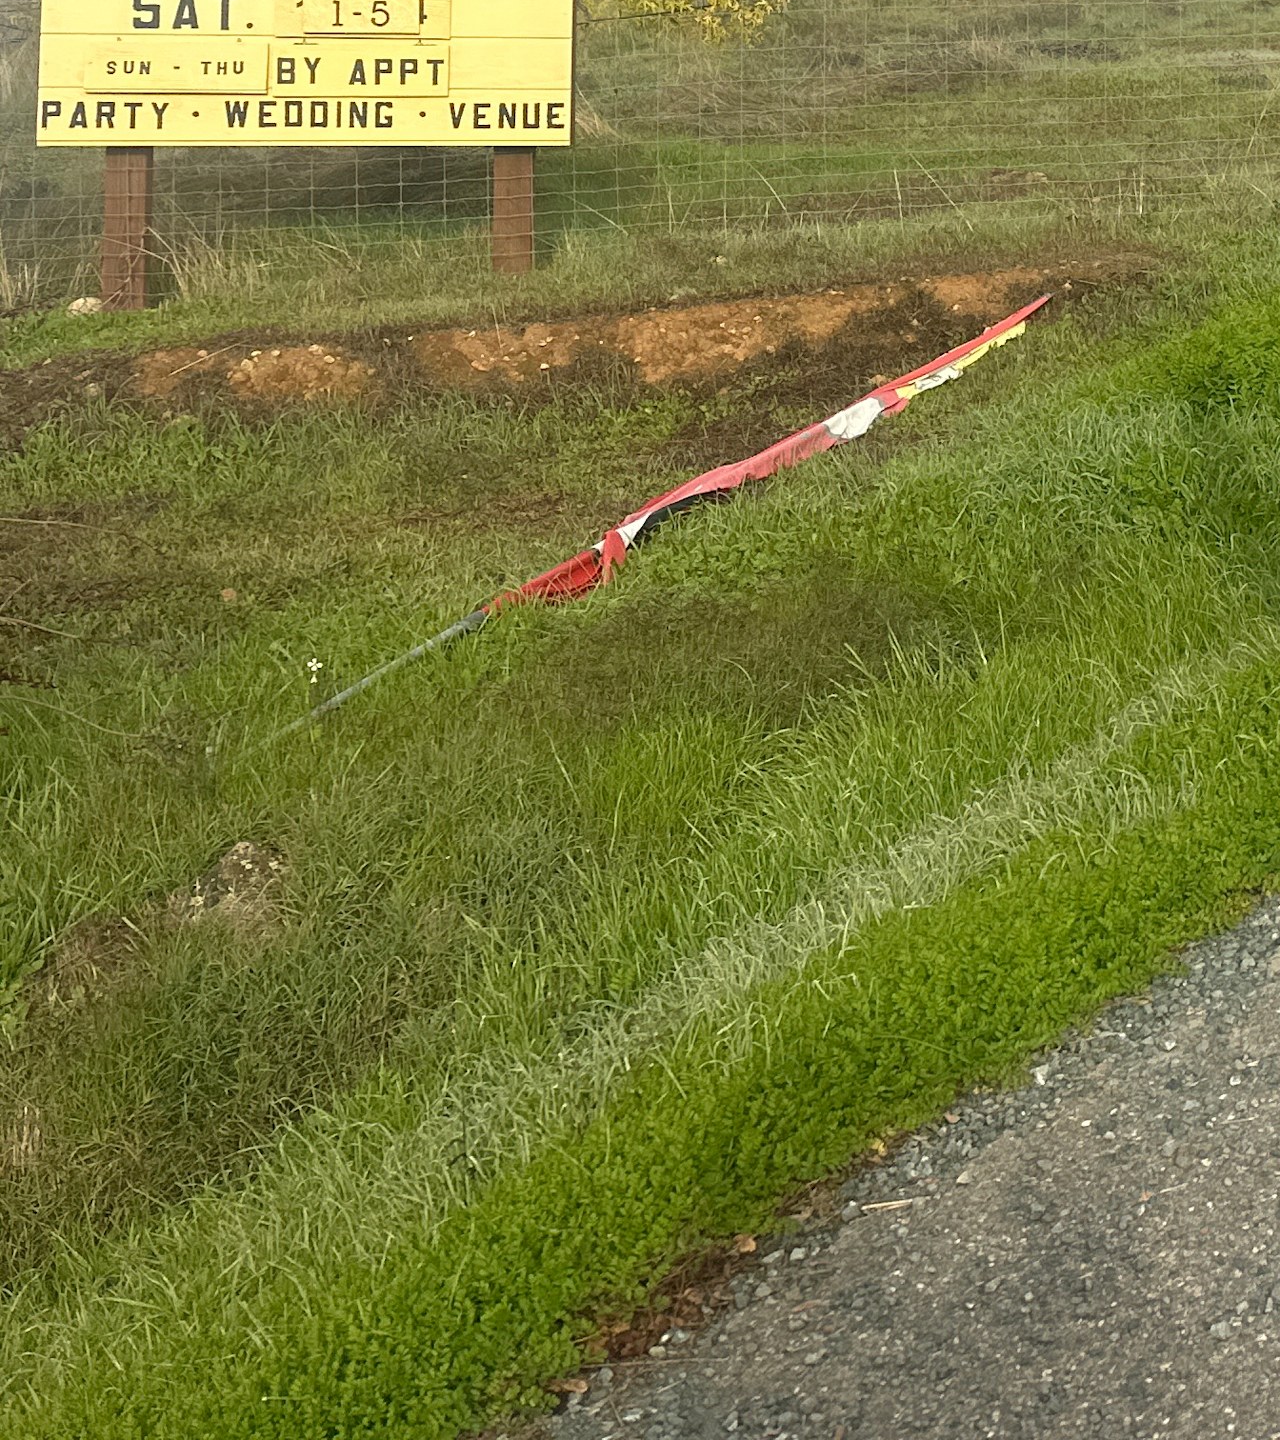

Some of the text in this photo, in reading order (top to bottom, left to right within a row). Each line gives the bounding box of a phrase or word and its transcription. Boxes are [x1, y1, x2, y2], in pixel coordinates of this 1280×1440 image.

[332, 0, 390, 27] 1-5
[107, 60, 151, 75] SUN
[200, 61, 244, 75] THU
[277, 57, 321, 85] BY
[348, 58, 445, 86] APPT
[41, 100, 565, 130] PARTY WEDDING VENUE
